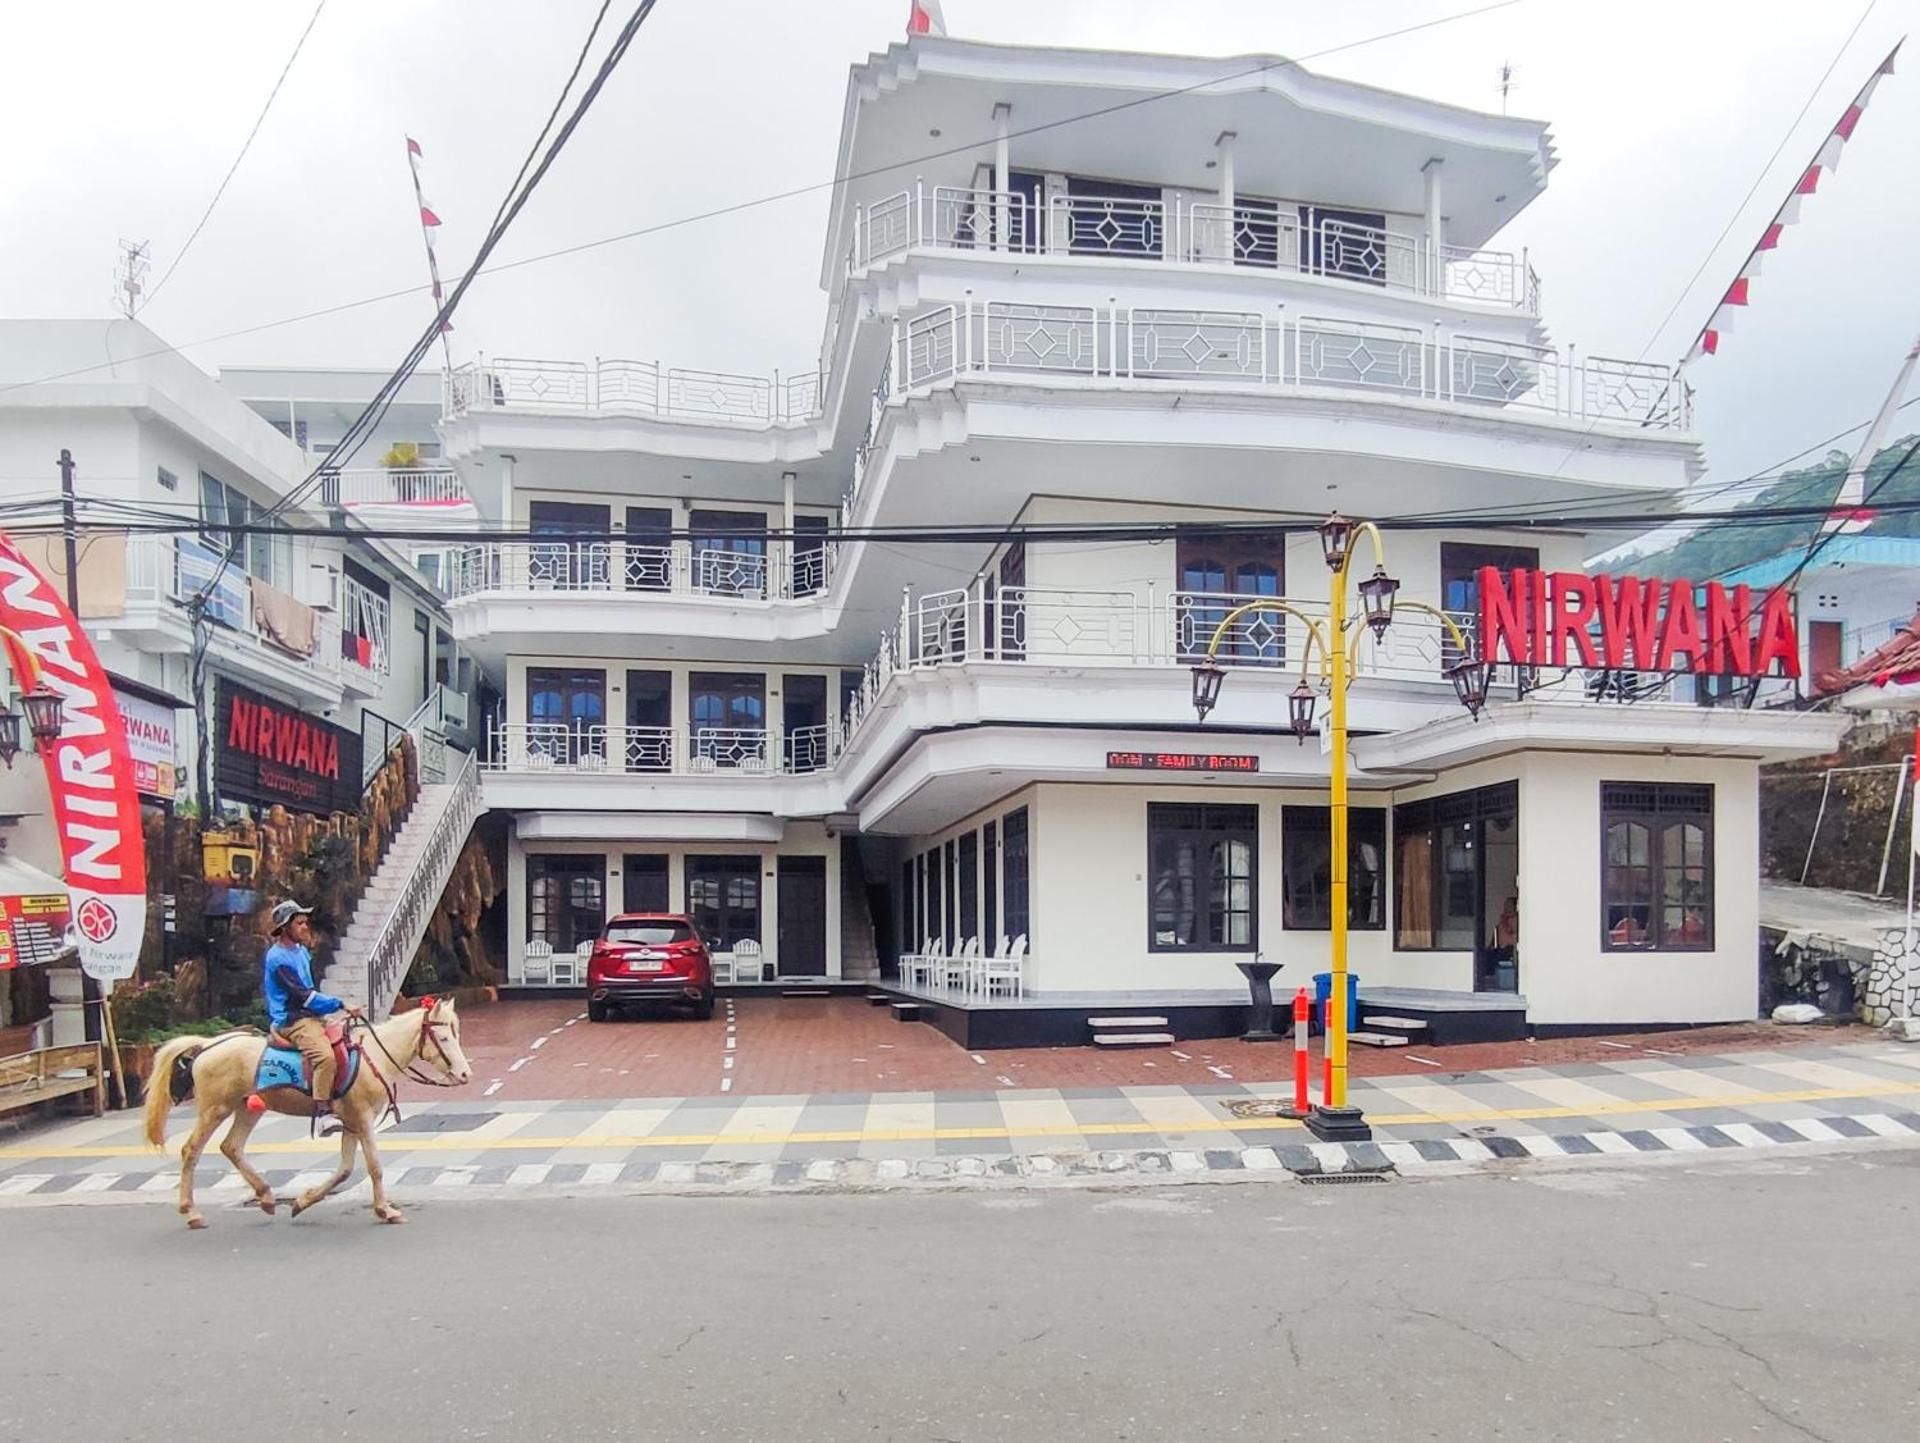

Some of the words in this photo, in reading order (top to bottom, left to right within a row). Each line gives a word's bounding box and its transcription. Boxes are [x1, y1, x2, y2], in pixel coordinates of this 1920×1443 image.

[1479, 565, 1801, 678] NIRWANA
[228, 695, 339, 780] NIRWANA
[1156, 755, 1207, 768] FAMILY
[1209, 756, 1252, 769] ROOM
[259, 763, 318, 800] Sarangan
